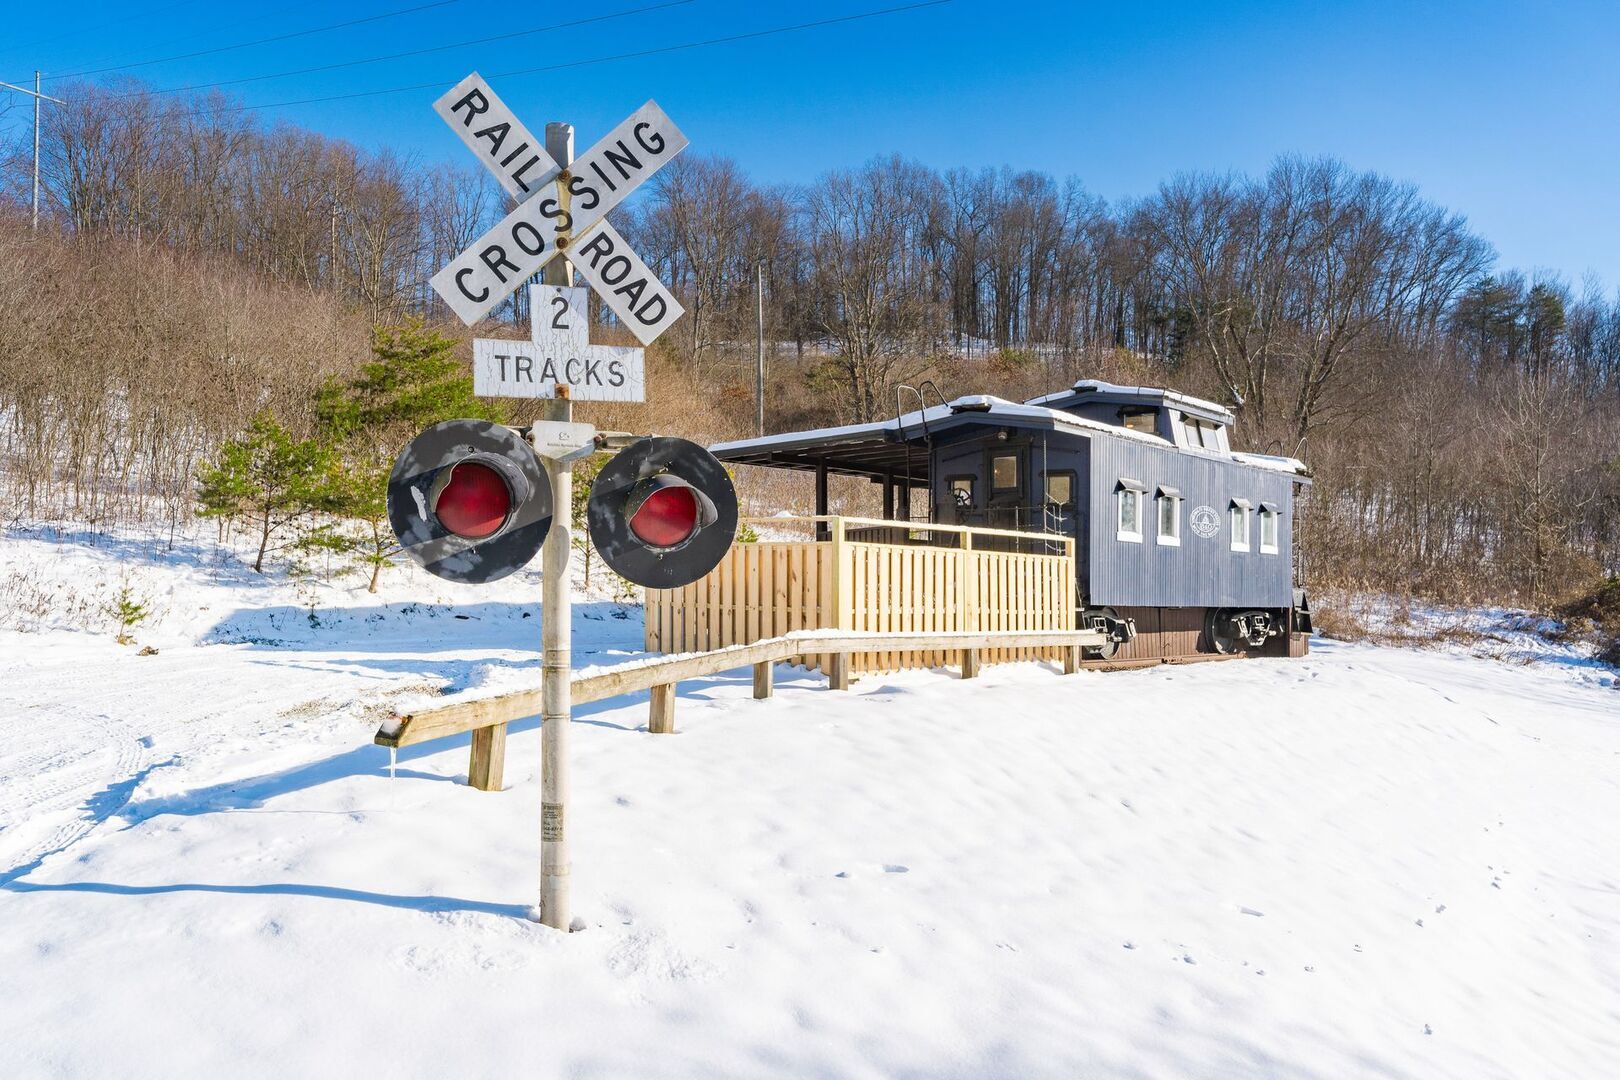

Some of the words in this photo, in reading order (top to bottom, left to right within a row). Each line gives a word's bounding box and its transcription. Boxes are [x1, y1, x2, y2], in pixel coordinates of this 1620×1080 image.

[450, 87, 541, 193] RAIL
[579, 231, 668, 327] ROAD
[454, 121, 666, 304] CROSSING
[550, 296, 570, 331] 2
[494, 354, 626, 388] TRACKS
